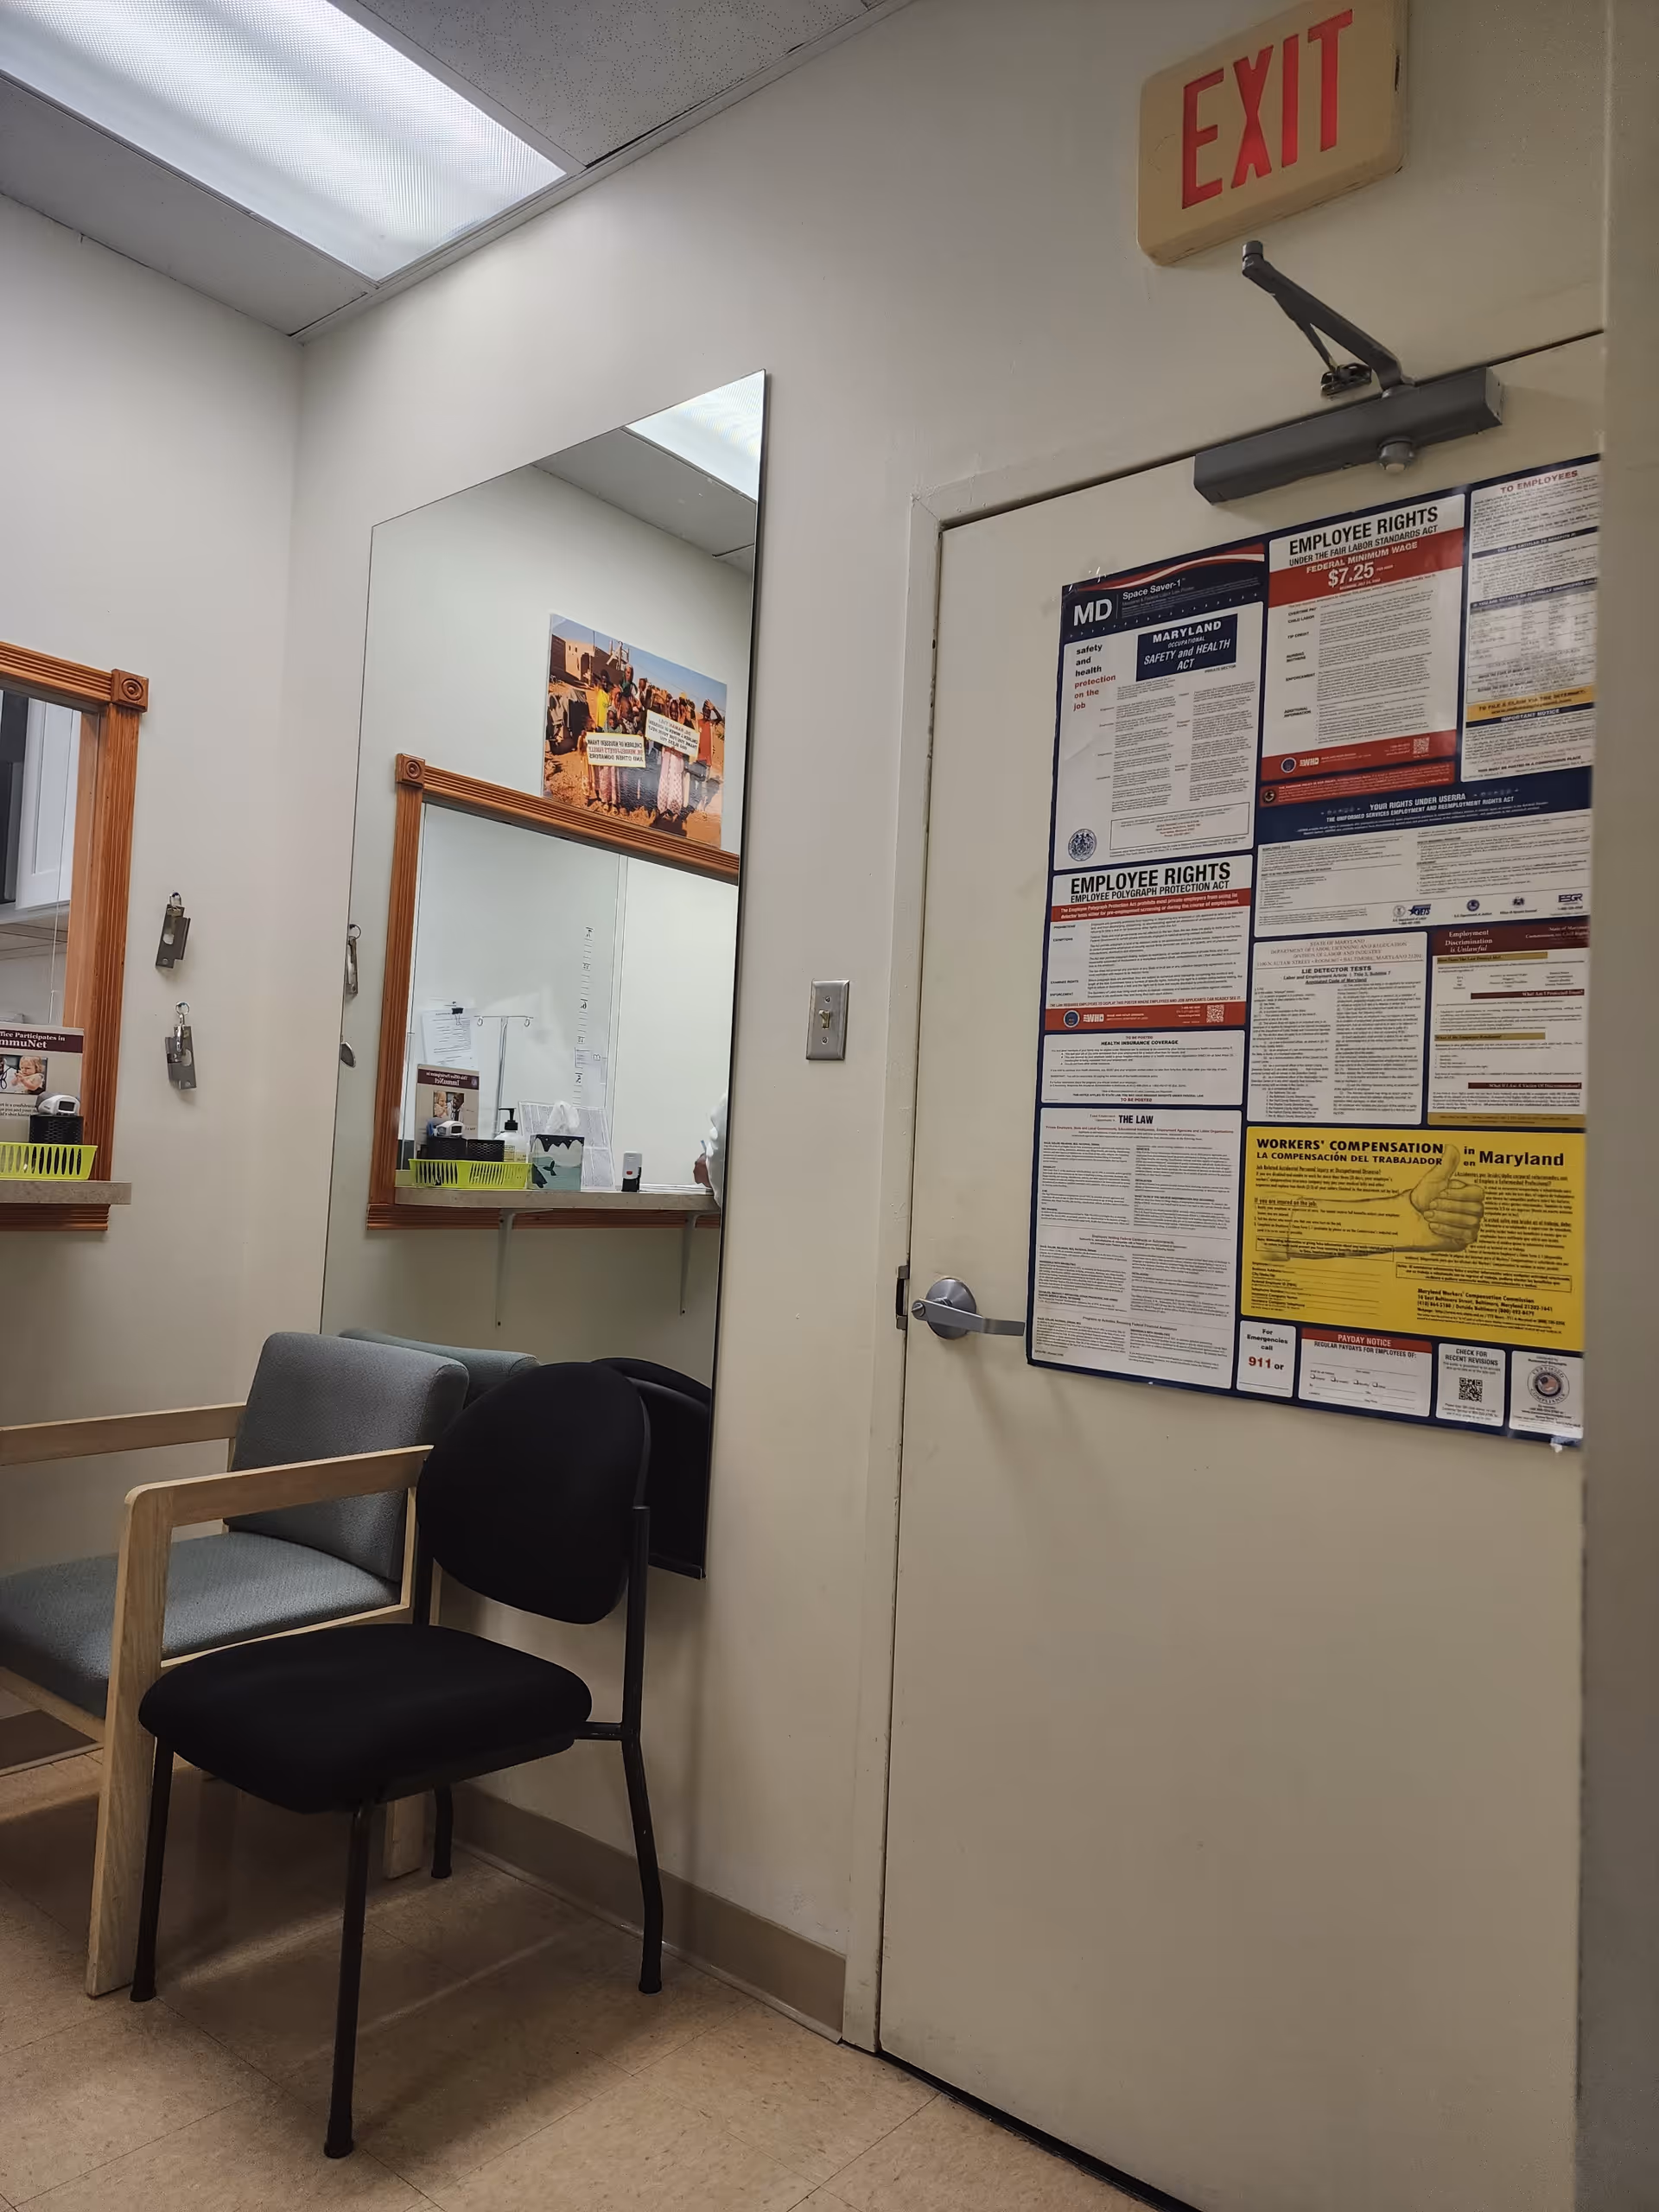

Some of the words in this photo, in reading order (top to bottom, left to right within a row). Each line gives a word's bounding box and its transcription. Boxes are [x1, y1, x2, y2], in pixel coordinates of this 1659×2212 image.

[1181, 8, 1354, 210] EXIT
[1500, 485, 1514, 494] TO
[1517, 469, 1579, 490] EMPLOYEES
[1289, 521, 1372, 556] EMPLOYEE
[1376, 505, 1439, 535] RIGHTS
[1289, 554, 1313, 567] UNDER
[1315, 550, 1329, 561] THE
[1330, 546, 1347, 558] FAIR
[1348, 541, 1373, 554] LABOR
[1375, 529, 1420, 546] STANDARDS
[1421, 524, 1438, 536] ACT
[1306, 559, 1345, 574] FEDERAL
[1347, 549, 1389, 565] MINIMUM
[1391, 541, 1418, 554] WAGE
[1327, 561, 1375, 588] $7.25
[1122, 588, 1148, 601] Space
[1149, 579, 1182, 594] Saver-1
[1073, 598, 1113, 626] MD
[1153, 620, 1222, 644] MARYLAND
[1076, 644, 1103, 655] safety
[1167, 635, 1205, 649] OCCUPATIONAL
[1143, 650, 1177, 665] SAFETY
[1177, 645, 1194, 658] and
[1196, 638, 1231, 655] HEALTH
[1076, 657, 1091, 666] and
[1176, 658, 1195, 671] ACT
[1075, 665, 1103, 677] health
[1074, 674, 1116, 690] protection
[1073, 702, 1086, 712] job
[1537, 709, 1560, 717] NOTICE
[1370, 802, 1388, 811] YOUR
[1389, 799, 1413, 810] RIGHTS
[1414, 796, 1438, 806] UNDER
[1438, 792, 1466, 803] USERRA
[1336, 813, 1365, 822] UNIFORMED
[1365, 810, 1390, 818] SERVICES
[1390, 806, 1426, 816] EMPLOYMENT
[1438, 799, 1481, 810] REEMPLOYMENT
[1482, 797, 1503, 805] RIGHTS
[1071, 869, 1159, 894] EMPLOYEE
[1164, 861, 1230, 885] RIGHTS
[1071, 891, 1110, 904] EMPLOYEE
[1111, 887, 1157, 899] POLYGRAPH
[1159, 882, 1211, 895] PROTECTION
[1211, 880, 1230, 890] ACT
[1448, 929, 1489, 939] Employment
[1445, 938, 1493, 946] Discrimination
[1457, 944, 1488, 953] Unlawful
[15, 1032, 57, 1041] Participates
[1118, 1115, 1134, 1124] THE
[1135, 1115, 1154, 1125] LAW
[1256, 1138, 1325, 1151] WORKERS'
[1329, 1140, 1444, 1154] COMPENSATION
[1256, 1151, 1268, 1160] LA
[1271, 1151, 1347, 1162] COMPENSACIÓN
[1351, 1154, 1369, 1163] DEL
[1372, 1155, 1443, 1166] TRABAJADOR
[1464, 1146, 1475, 1155] in
[1479, 1150, 1564, 1167] Maryland
[1465, 1292, 1502, 1301] Compensation
[1246, 1333, 1289, 1345] Emergencies
[1337, 1334, 1365, 1344] PAYDAY
[1366, 1338, 1392, 1347] NOTICE
[1313, 1340, 1338, 1350] REGULAR
[1338, 1344, 1363, 1352] PAYDAYS
[1375, 1347, 1407, 1357] EMPLOYEES
[1248, 1356, 1272, 1370] 911
[1445, 1354, 1467, 1363] RECENT
[1468, 1357, 1499, 1367] REVISIONS
